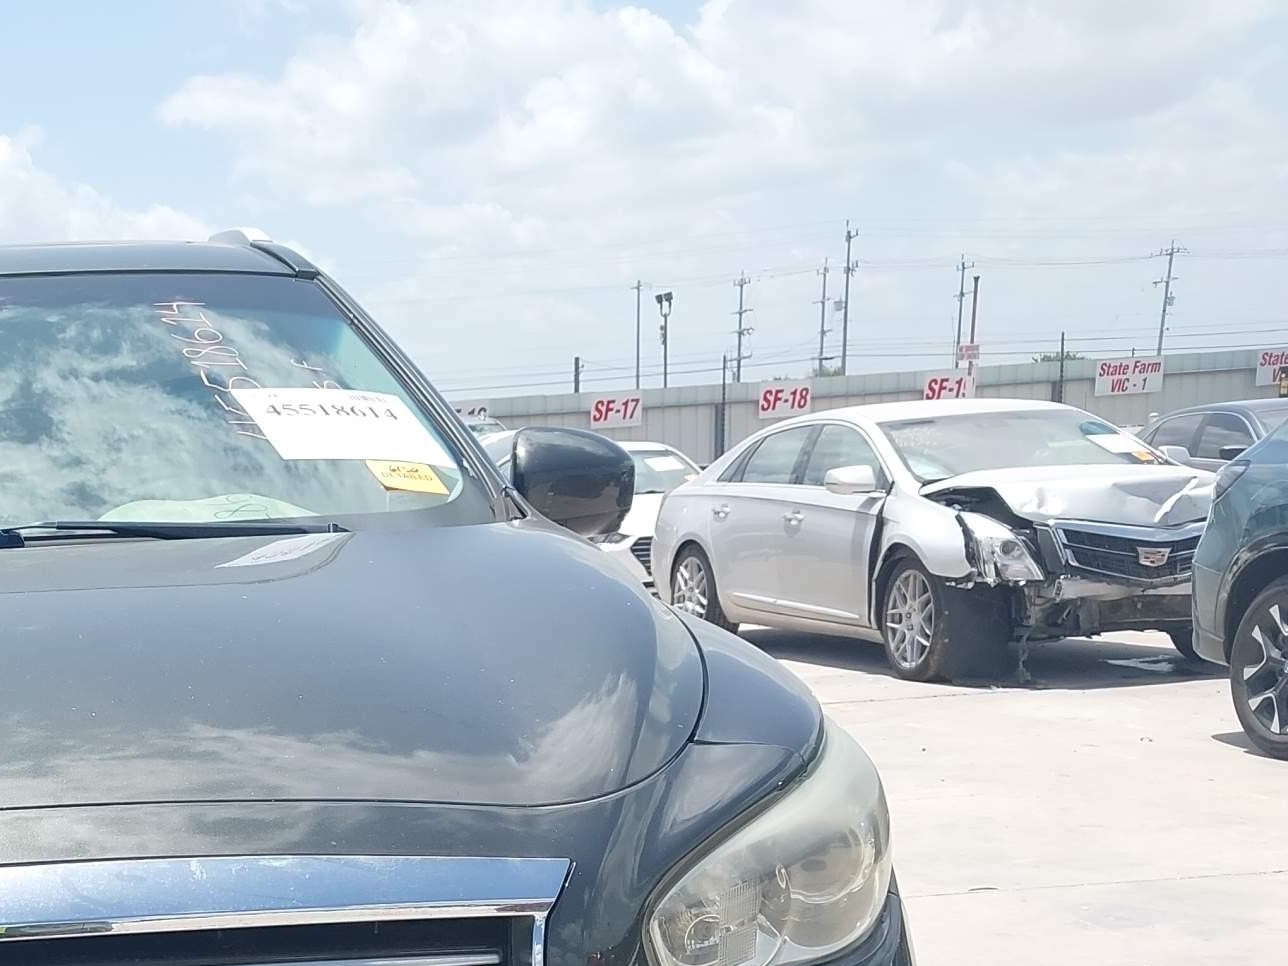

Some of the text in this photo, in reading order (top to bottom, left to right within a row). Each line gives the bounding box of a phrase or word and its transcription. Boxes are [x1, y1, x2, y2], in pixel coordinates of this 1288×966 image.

[1099, 360, 1161, 377] State Farm
[925, 376, 974, 400] SF-1
[1111, 377, 1129, 393] VIC
[1141, 376, 1148, 391] 1
[761, 387, 809, 412] SF-18
[265, 403, 399, 421] 45518614
[592, 398, 641, 423] SF-17
